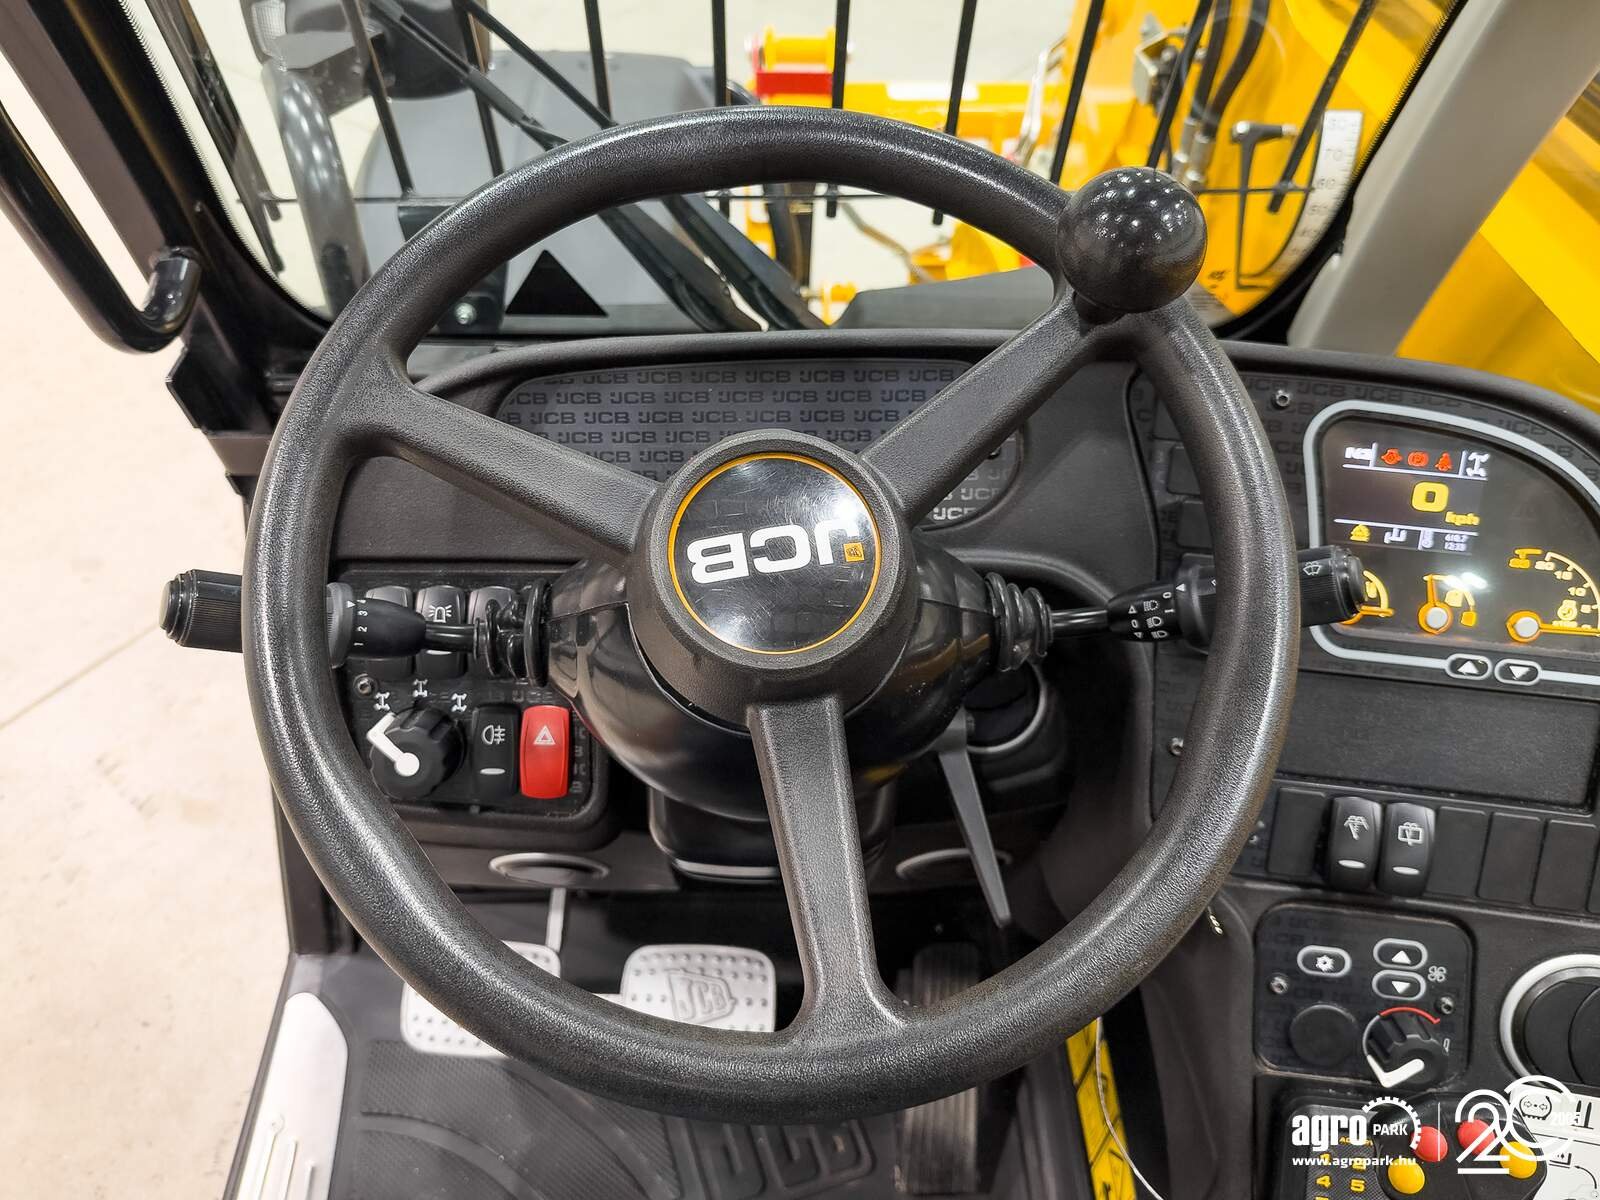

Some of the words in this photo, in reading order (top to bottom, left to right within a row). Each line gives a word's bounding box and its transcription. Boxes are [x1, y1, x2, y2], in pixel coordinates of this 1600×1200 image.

[637, 371, 683, 384] JCB
[691, 371, 737, 384] JCB
[746, 370, 792, 383] JCB
[800, 370, 845, 383] JCB
[854, 369, 900, 382] JCB
[556, 391, 601, 405] JCB
[610, 391, 656, 404] JCB
[664, 391, 710, 404] JCB
[718, 391, 764, 403] JCB
[772, 390, 818, 403] JCB
[826, 390, 872, 402] JCB
[881, 390, 926, 402] JCB
[529, 412, 576, 425] JCB
[584, 412, 630, 425] JCB
[638, 411, 684, 424] JCB
[692, 411, 738, 424] JCB
[746, 411, 792, 423] JCB
[800, 410, 845, 423] JCB
[557, 431, 604, 444] JCB
[611, 431, 657, 444] JCB
[665, 431, 711, 443] JCB
[639, 450, 685, 463] JCB
[1412, 481, 1449, 513] 0
[687, 518, 865, 585] JCB
[1316, 1175, 1332, 1188] 4
[1350, 1179, 1366, 1192] 5
